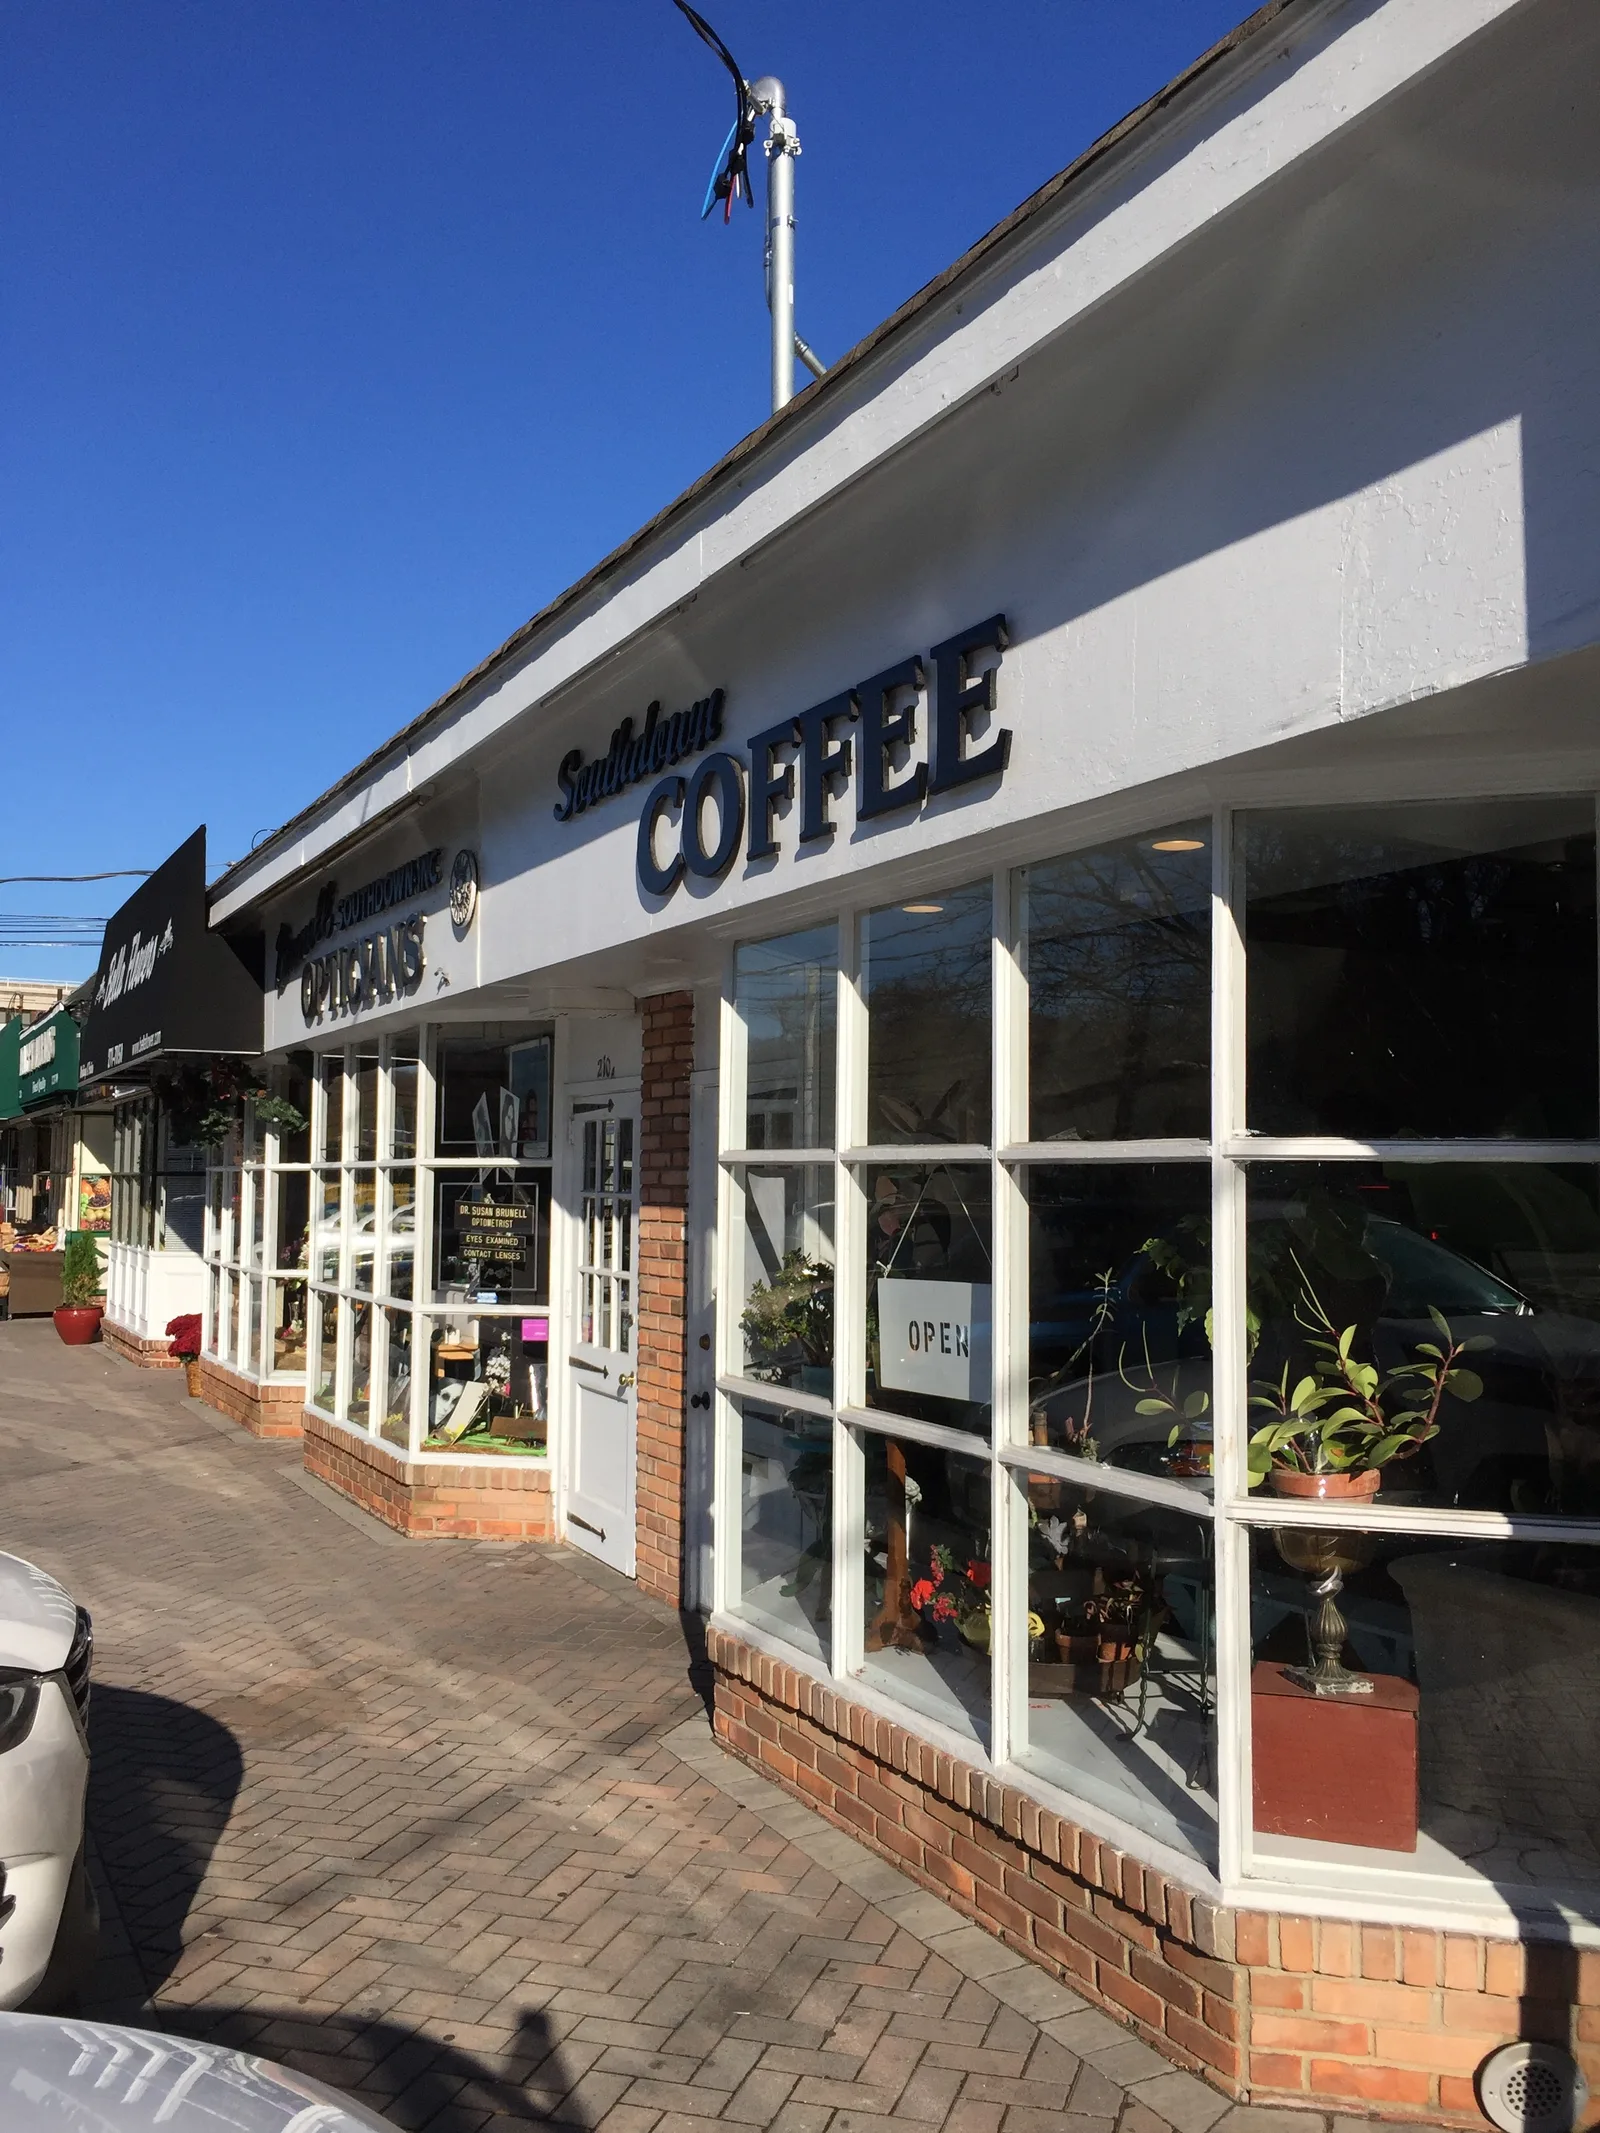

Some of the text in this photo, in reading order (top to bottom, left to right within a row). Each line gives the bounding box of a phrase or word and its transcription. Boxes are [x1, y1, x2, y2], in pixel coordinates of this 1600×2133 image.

[553, 688, 724, 822] Southdown
[637, 613, 1013, 896] COFFEE
[301, 912, 427, 1021] OPTICIANS
[471, 1218, 513, 1228] OPTOMETRIST
[472, 1206, 493, 1217] SUSAN
[495, 1208, 527, 1218] BRUNELL
[466, 1235, 518, 1246] EYES EXAMINED
[463, 1249, 520, 1260] CONTACT LENSES
[908, 1320, 969, 1358] OPEN
